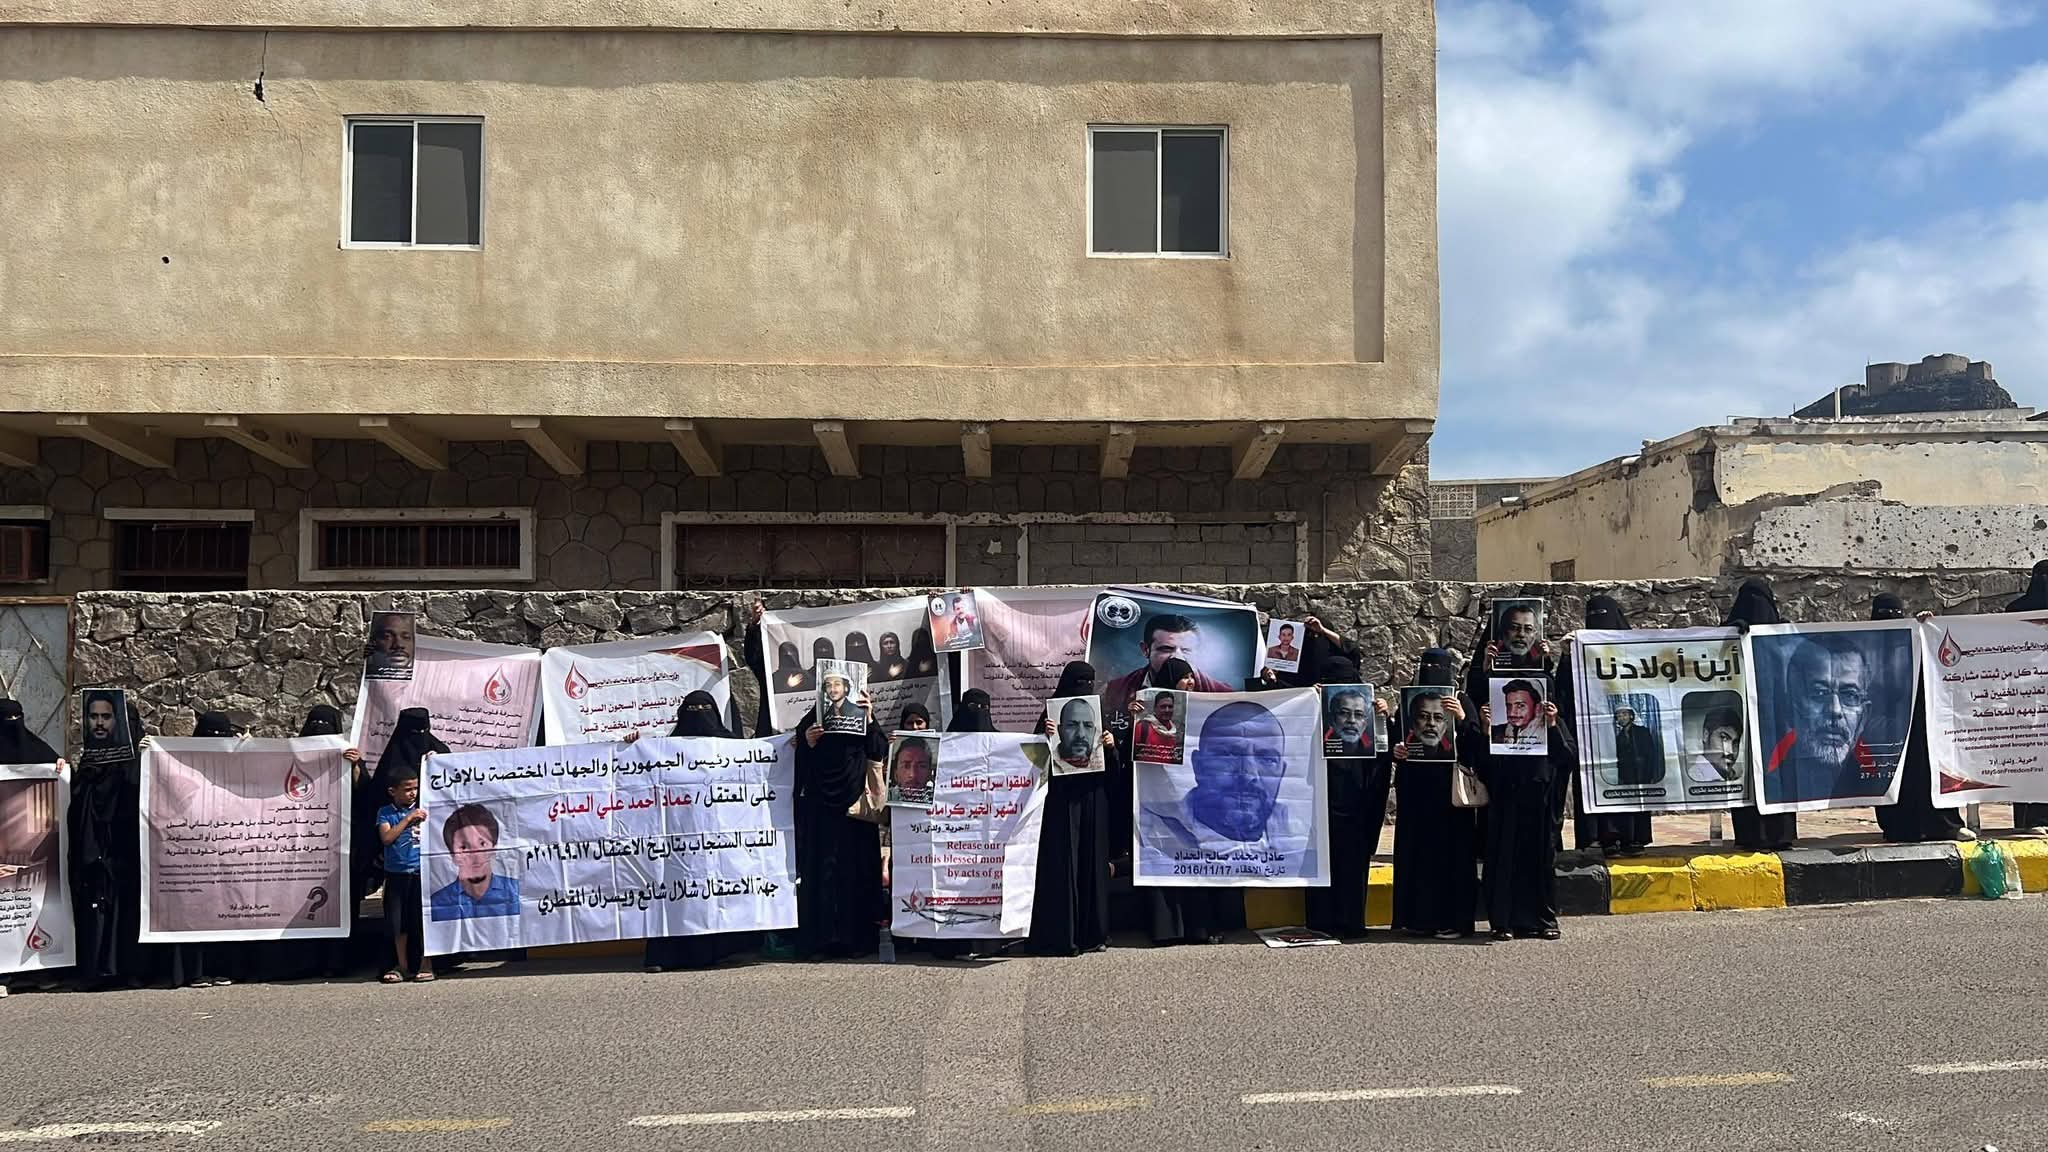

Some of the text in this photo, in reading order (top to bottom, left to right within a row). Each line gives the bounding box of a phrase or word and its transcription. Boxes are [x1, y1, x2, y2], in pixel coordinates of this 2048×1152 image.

[1595, 646, 1740, 683] أين أولادنا
[1943, 671, 1978, 682] مشاركته
[1980, 668, 1999, 680] ثبتت
[2002, 671, 2012, 680] من
[2014, 669, 2031, 679] كل
[1971, 686, 2045, 700] تعذيب المخفيين قسرا
[580, 704, 606, 715] السرية
[609, 702, 636, 712] السجون
[1973, 708, 2014, 717] للمحاكمة
[580, 725, 599, 735] قسرا
[601, 722, 629, 733] المخفيين
[631, 720, 650, 730] مصير
[652, 718, 665, 728] عن
[612, 752, 684, 774] الجمهورية
[688, 757, 730, 770] رئيس
[734, 750, 778, 769] نطالب
[489, 762, 547, 782] المختصة
[551, 758, 608, 778] والجهات
[980, 776, 1003, 791] سراح
[628, 785, 657, 809] أحمد
[662, 788, 692, 806] عماد
[704, 785, 747, 808] المعتقل
[751, 783, 777, 806] على
[548, 793, 593, 821] العبادي
[596, 790, 625, 818] علي
[968, 805, 991, 818] الخير
[689, 831, 741, 855] السنجاب
[745, 829, 777, 852] اللقب
[947, 841, 981, 850] Release
[593, 837, 644, 860] الاعتقال
[647, 836, 686, 861] بتاريخ
[911, 854, 922, 864] Let
[924, 854, 940, 863] this
[944, 854, 977, 864] blessed
[1174, 850, 1285, 864] عادل محمد صالح الحداد
[948, 869, 959, 879] by
[961, 869, 980, 877] acts
[982, 868, 991, 877] of
[1174, 865, 1232, 875] 2016/11/17
[1264, 866, 1285, 877] تاريخ
[538, 875, 779, 915] جهة الاعتقال شلال شائع ويسران المقطري
